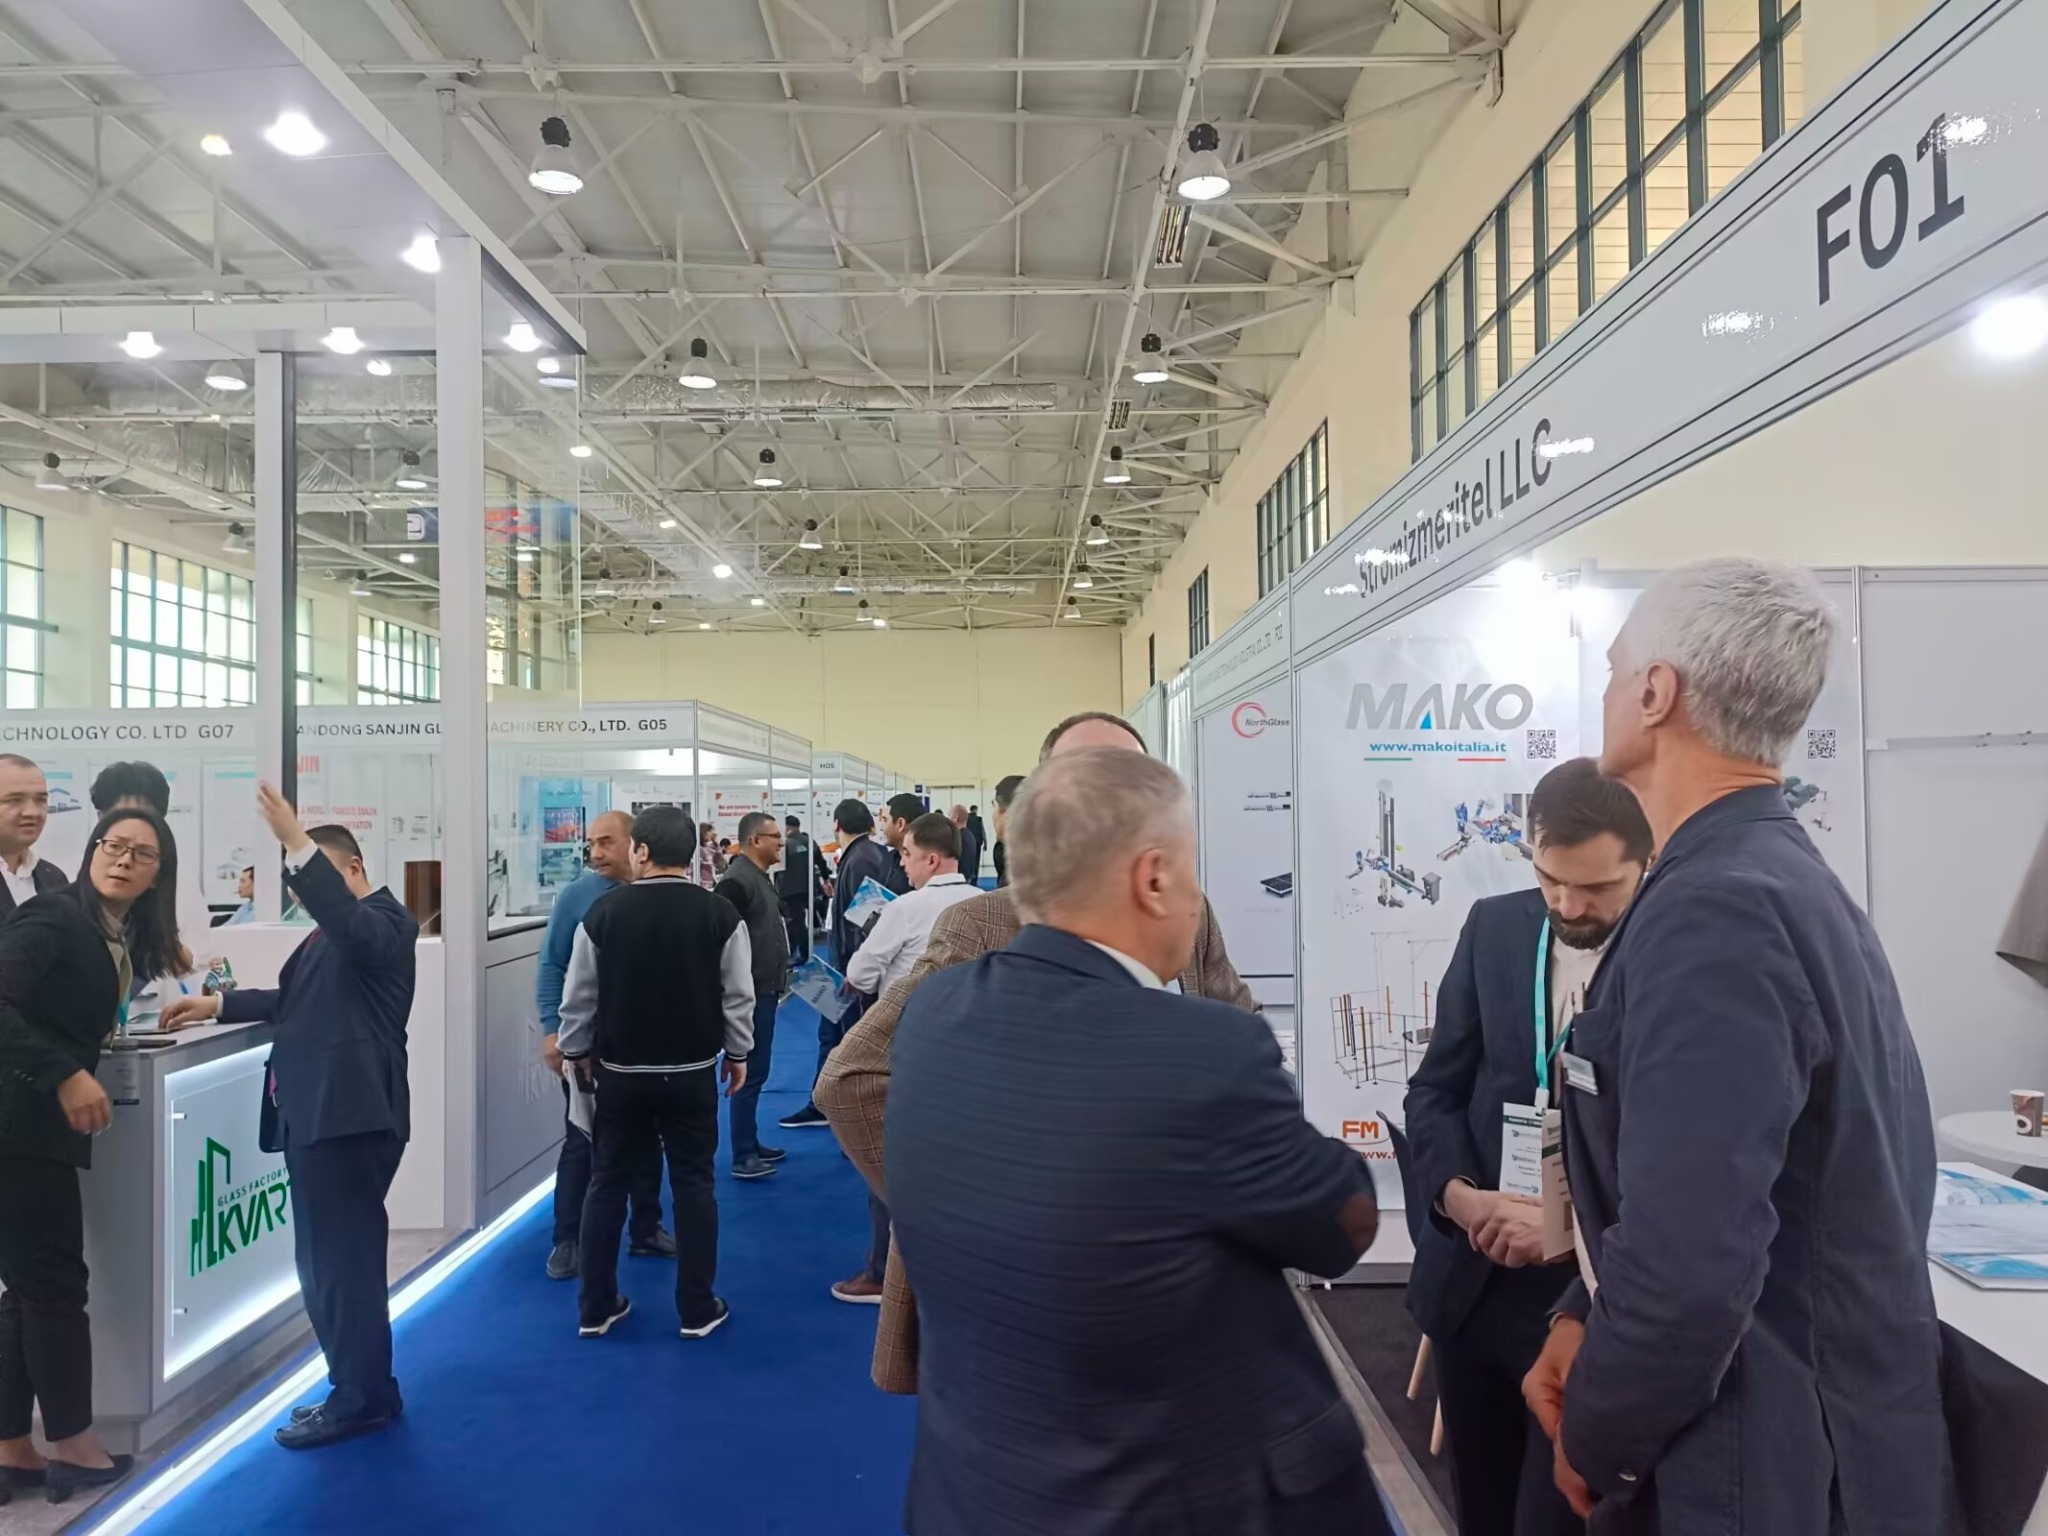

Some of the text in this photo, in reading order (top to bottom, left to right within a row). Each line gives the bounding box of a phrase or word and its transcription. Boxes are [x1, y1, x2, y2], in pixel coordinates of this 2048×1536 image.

[1817, 112, 1965, 306] F01
[1500, 417, 1552, 510] LLC
[1345, 683, 1534, 731] MAKO
[366, 723, 420, 735] SANJIN
[600, 720, 631, 731] LTD.
[638, 719, 668, 731] G05
[1245, 717, 1290, 727] NorthGlass
[116, 725, 147, 740] CO.
[153, 725, 187, 739] LTD
[199, 724, 234, 739] G07
[1369, 741, 1507, 753] www.makoitalia.it
[1342, 1120, 1379, 1139] FM
[218, 1186, 247, 1207] GLASS
